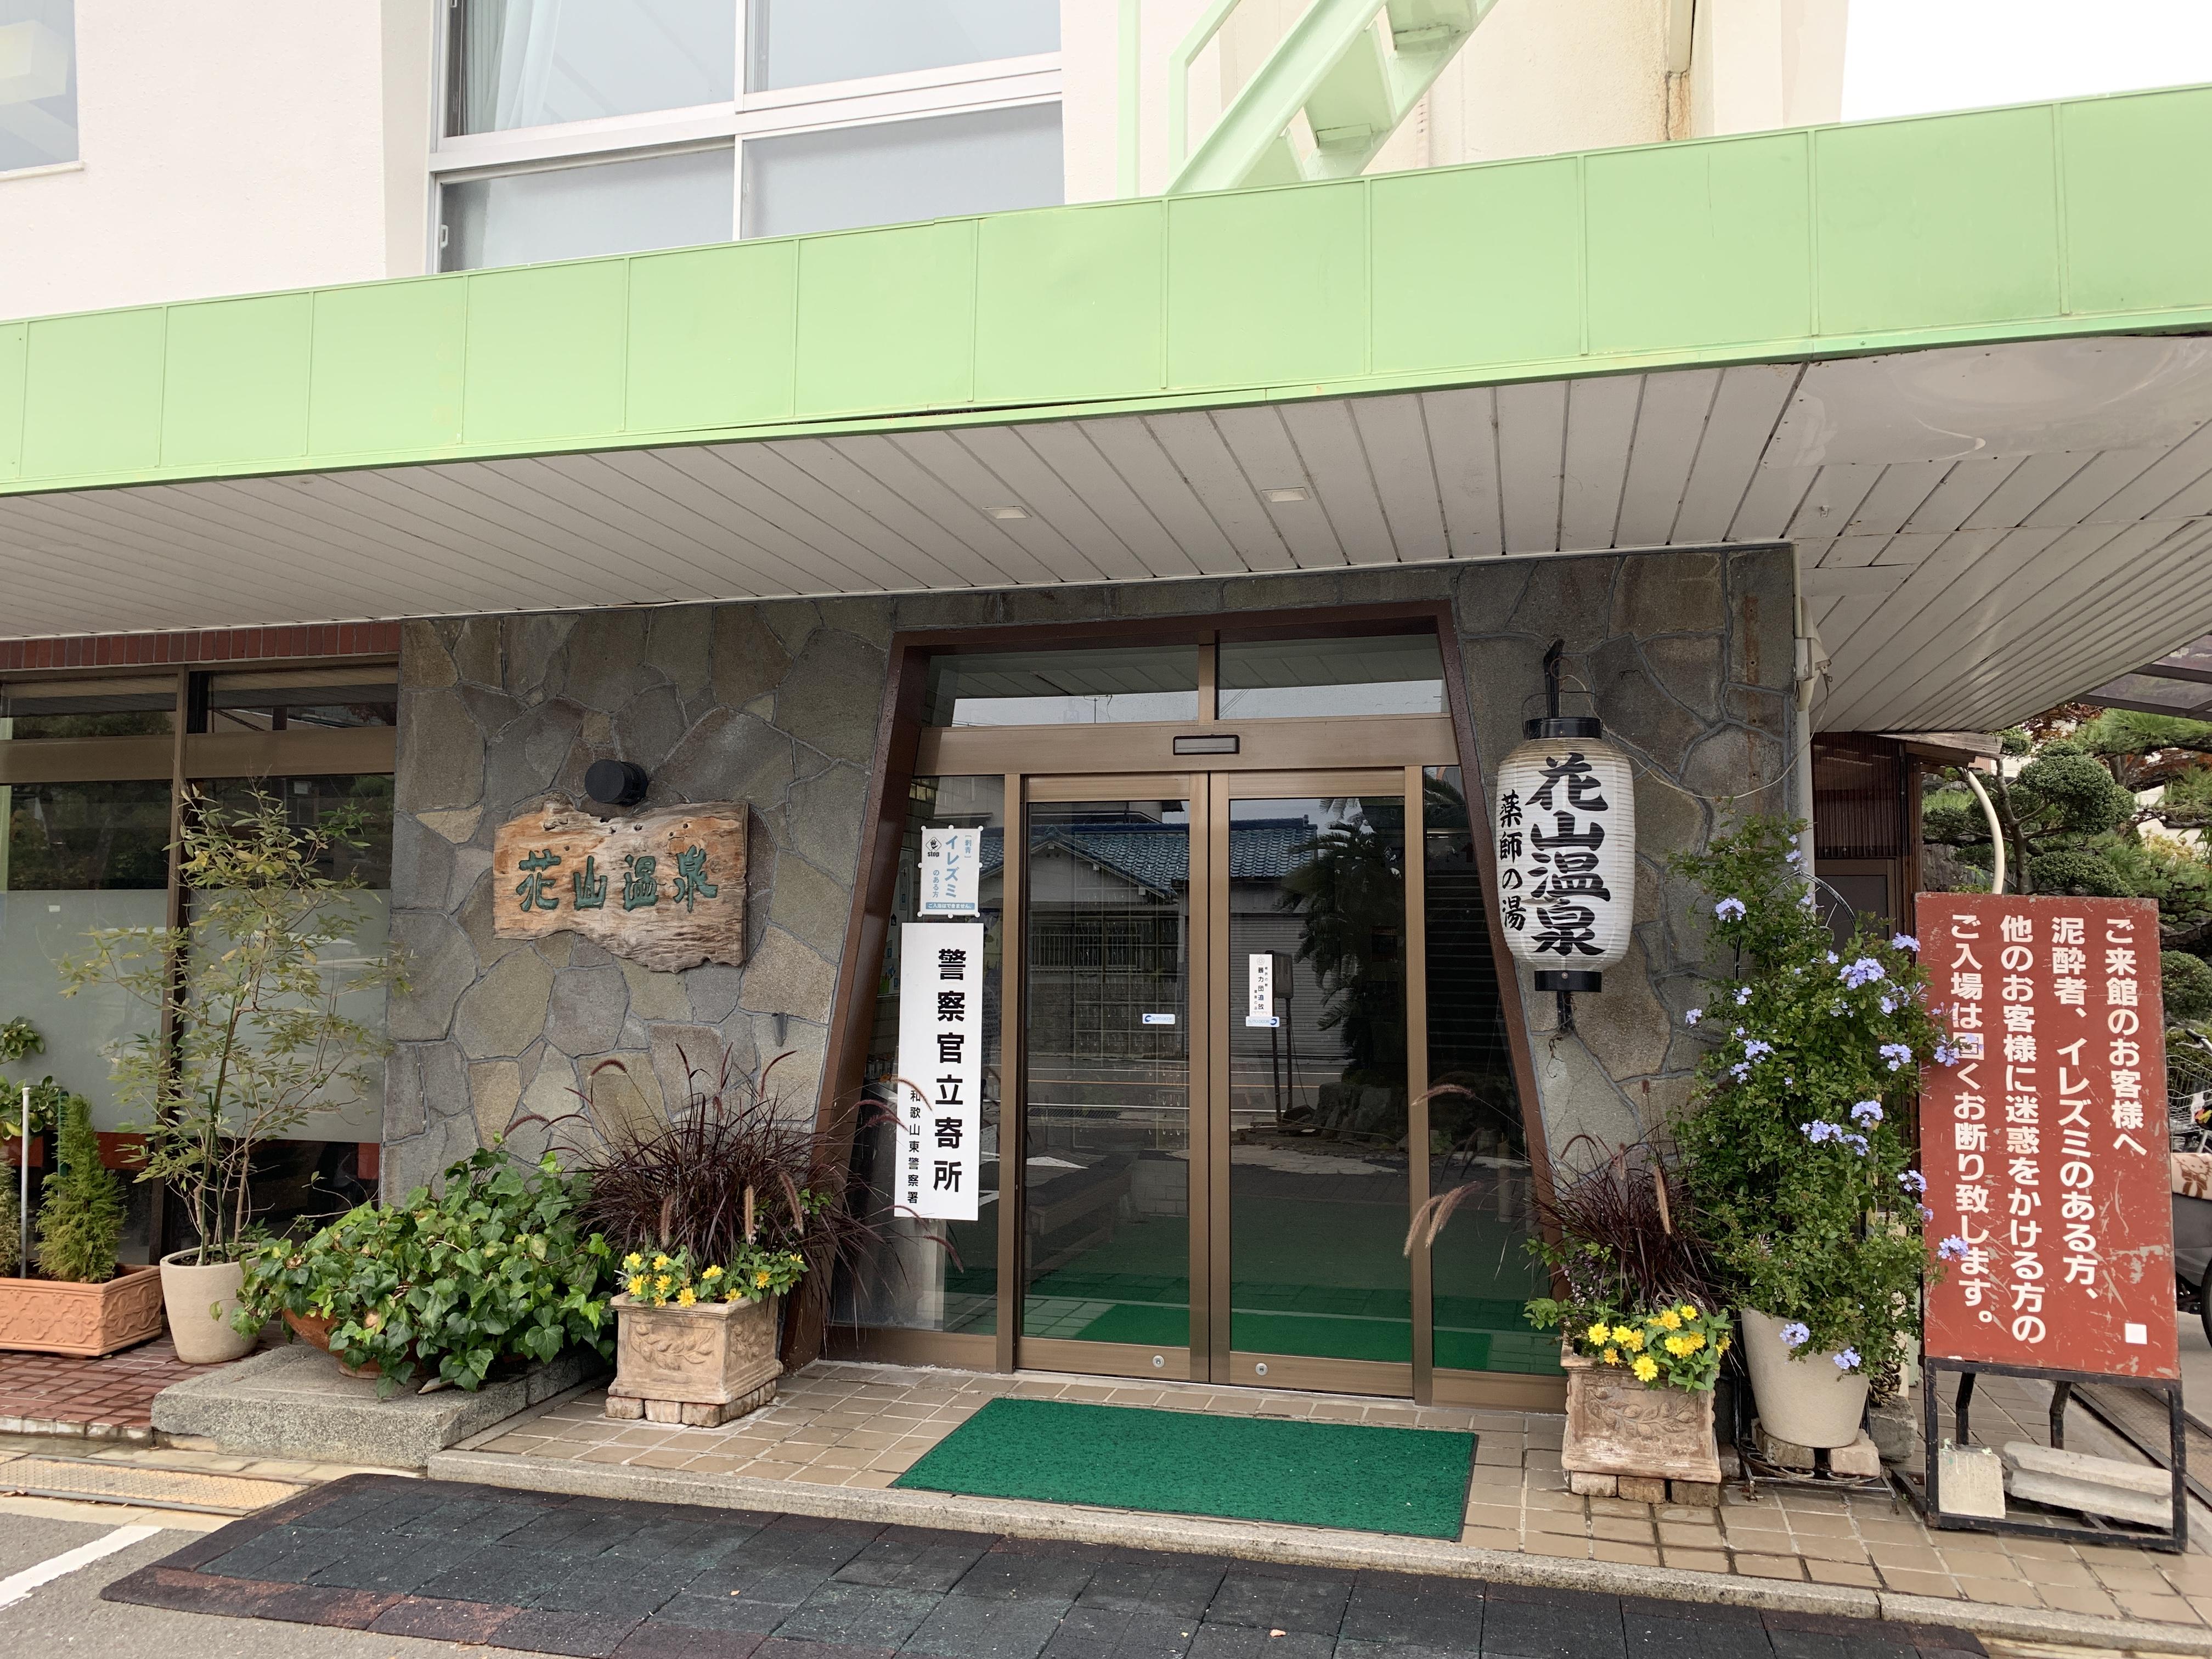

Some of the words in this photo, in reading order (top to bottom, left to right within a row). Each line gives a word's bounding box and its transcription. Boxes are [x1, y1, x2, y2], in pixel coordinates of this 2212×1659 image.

[516, 845, 718, 913] 花山温泉
[945, 835, 960, 898] イレズミ
[1499, 788, 1527, 932] 薬師の湯
[1525, 752, 1611, 957] 花山温泉
[933, 949, 967, 1193] 警察官立寄所
[2105, 918, 2147, 1156] ご来館のお客様へ
[907, 1090, 921, 1204] 和歌山東警察署
[2000, 915, 2046, 1344] 他のお客様に迷惑をかける方の
